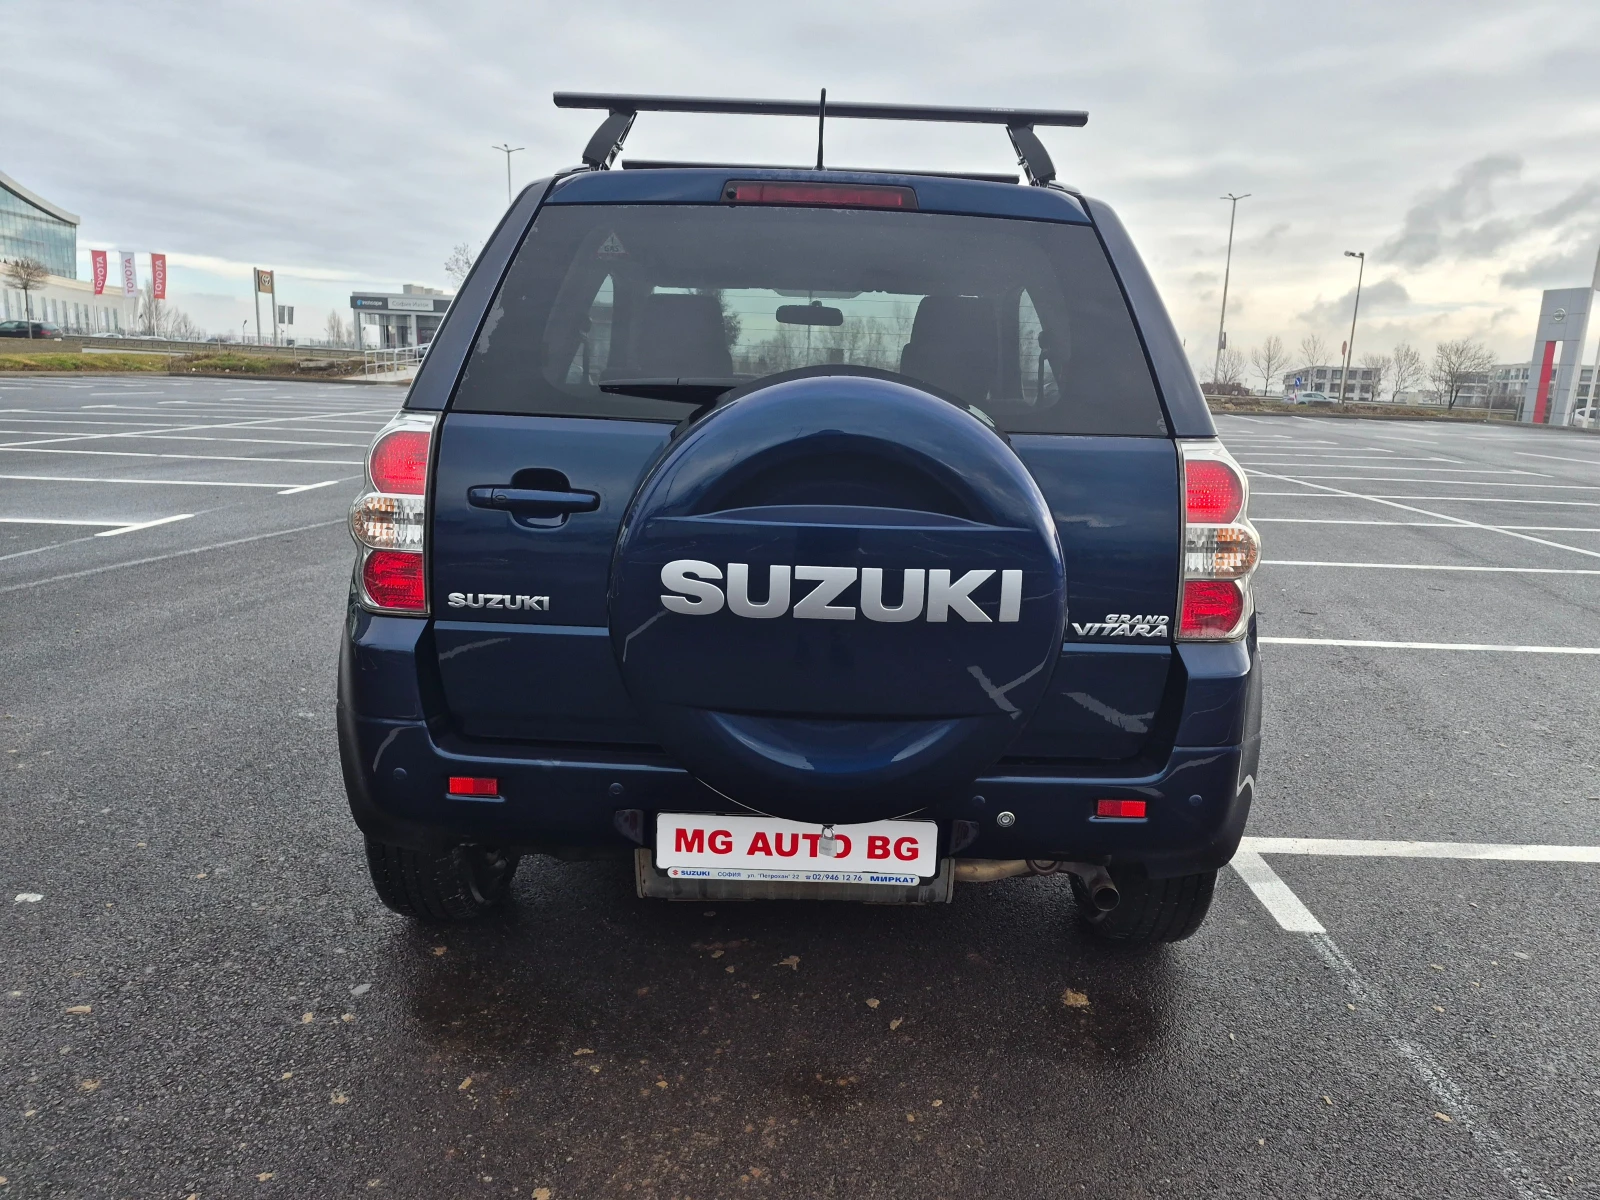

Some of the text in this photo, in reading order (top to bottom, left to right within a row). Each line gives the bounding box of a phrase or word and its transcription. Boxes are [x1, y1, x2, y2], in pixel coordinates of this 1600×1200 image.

[95, 256, 104, 291] TOYOTA
[124, 258, 134, 294] TOYOTA
[154, 259, 163, 296] TOYOTA
[447, 592, 550, 611] SUZUKI
[660, 559, 1023, 623] SUZUKI
[1071, 622, 1168, 638] VITARA
[1105, 613, 1170, 625] GRAND
[674, 828, 733, 855] MG
[866, 835, 919, 861] BG
[812, 873, 839, 881] 02/946
